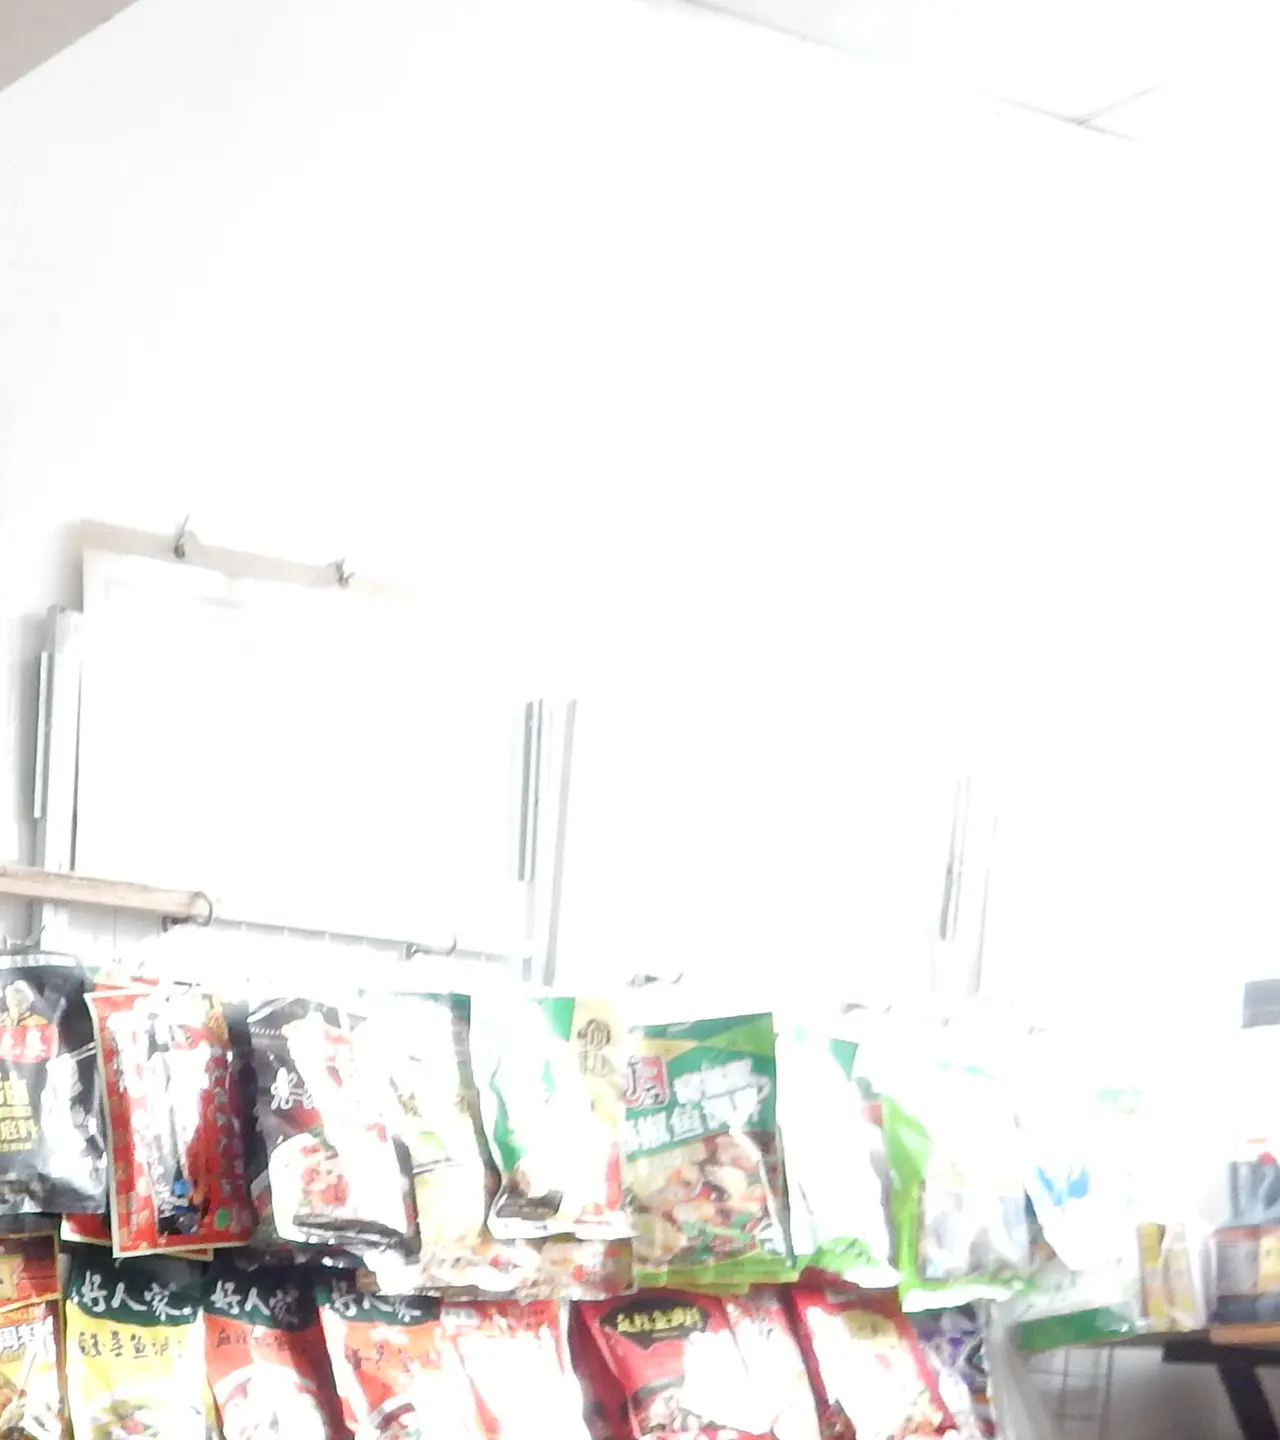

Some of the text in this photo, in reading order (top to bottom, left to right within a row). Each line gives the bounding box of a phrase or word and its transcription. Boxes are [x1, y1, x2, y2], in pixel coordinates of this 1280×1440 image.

[80, 1271, 192, 1322] 好人家
[210, 1279, 300, 1325] 好人家
